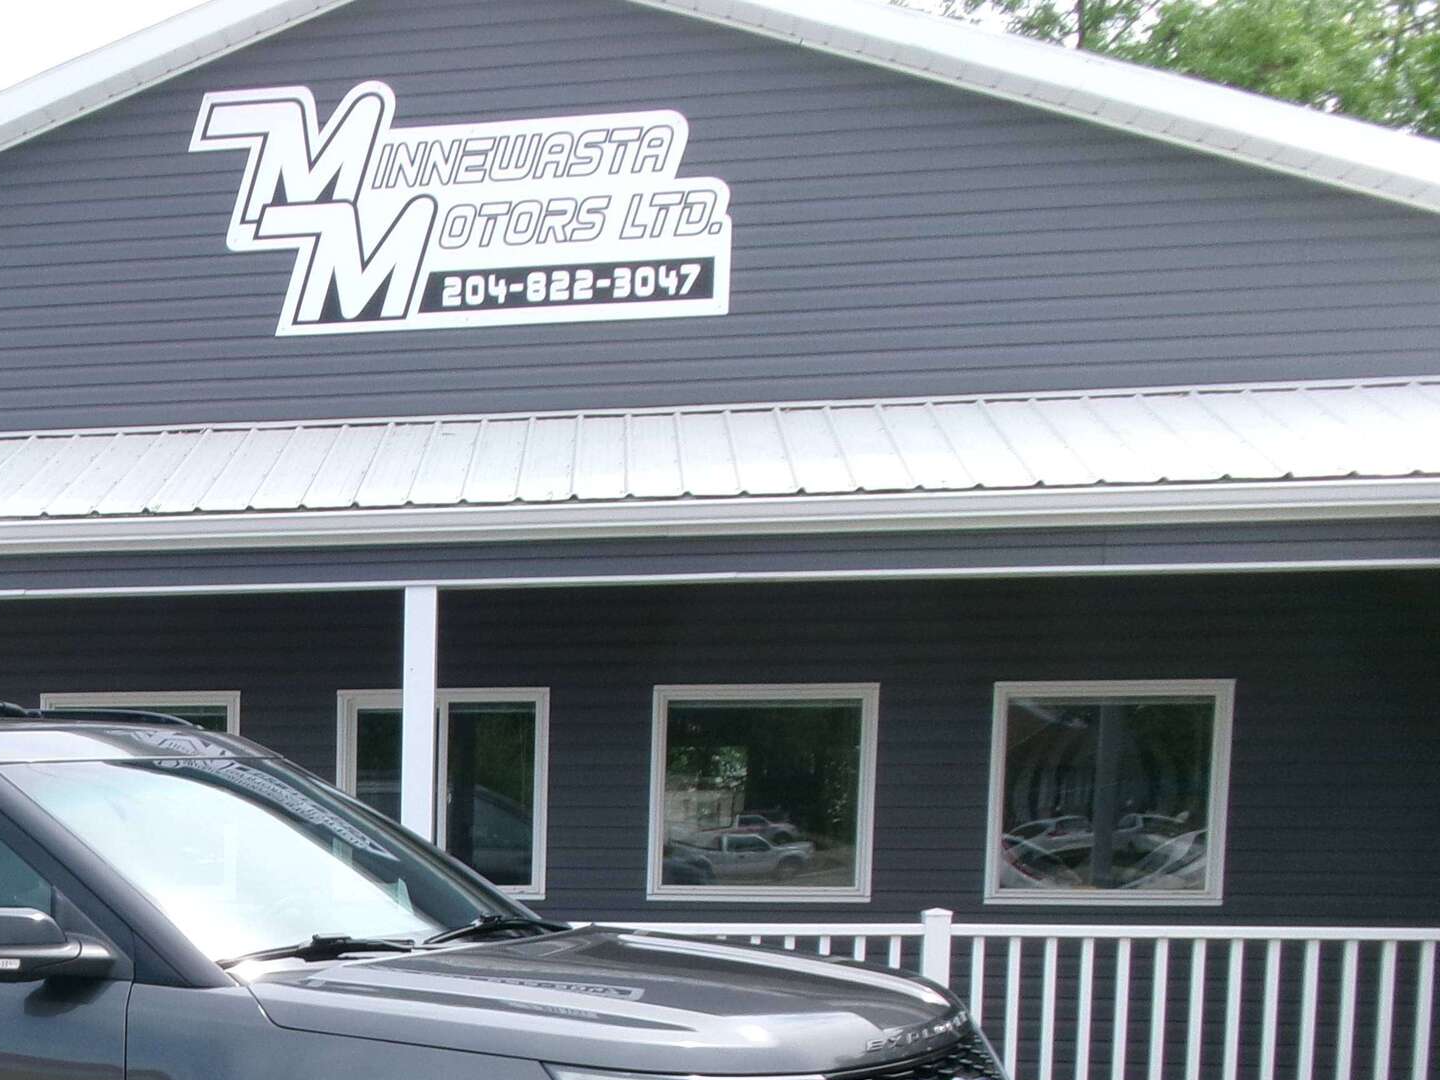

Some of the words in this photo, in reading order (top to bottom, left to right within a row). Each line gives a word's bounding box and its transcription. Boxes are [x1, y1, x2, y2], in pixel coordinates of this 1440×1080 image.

[200, 92, 674, 225] MINNEWASTA
[253, 193, 612, 326] MOTORS
[619, 189, 723, 240] LTD.
[442, 264, 701, 307] 204-822-3047
